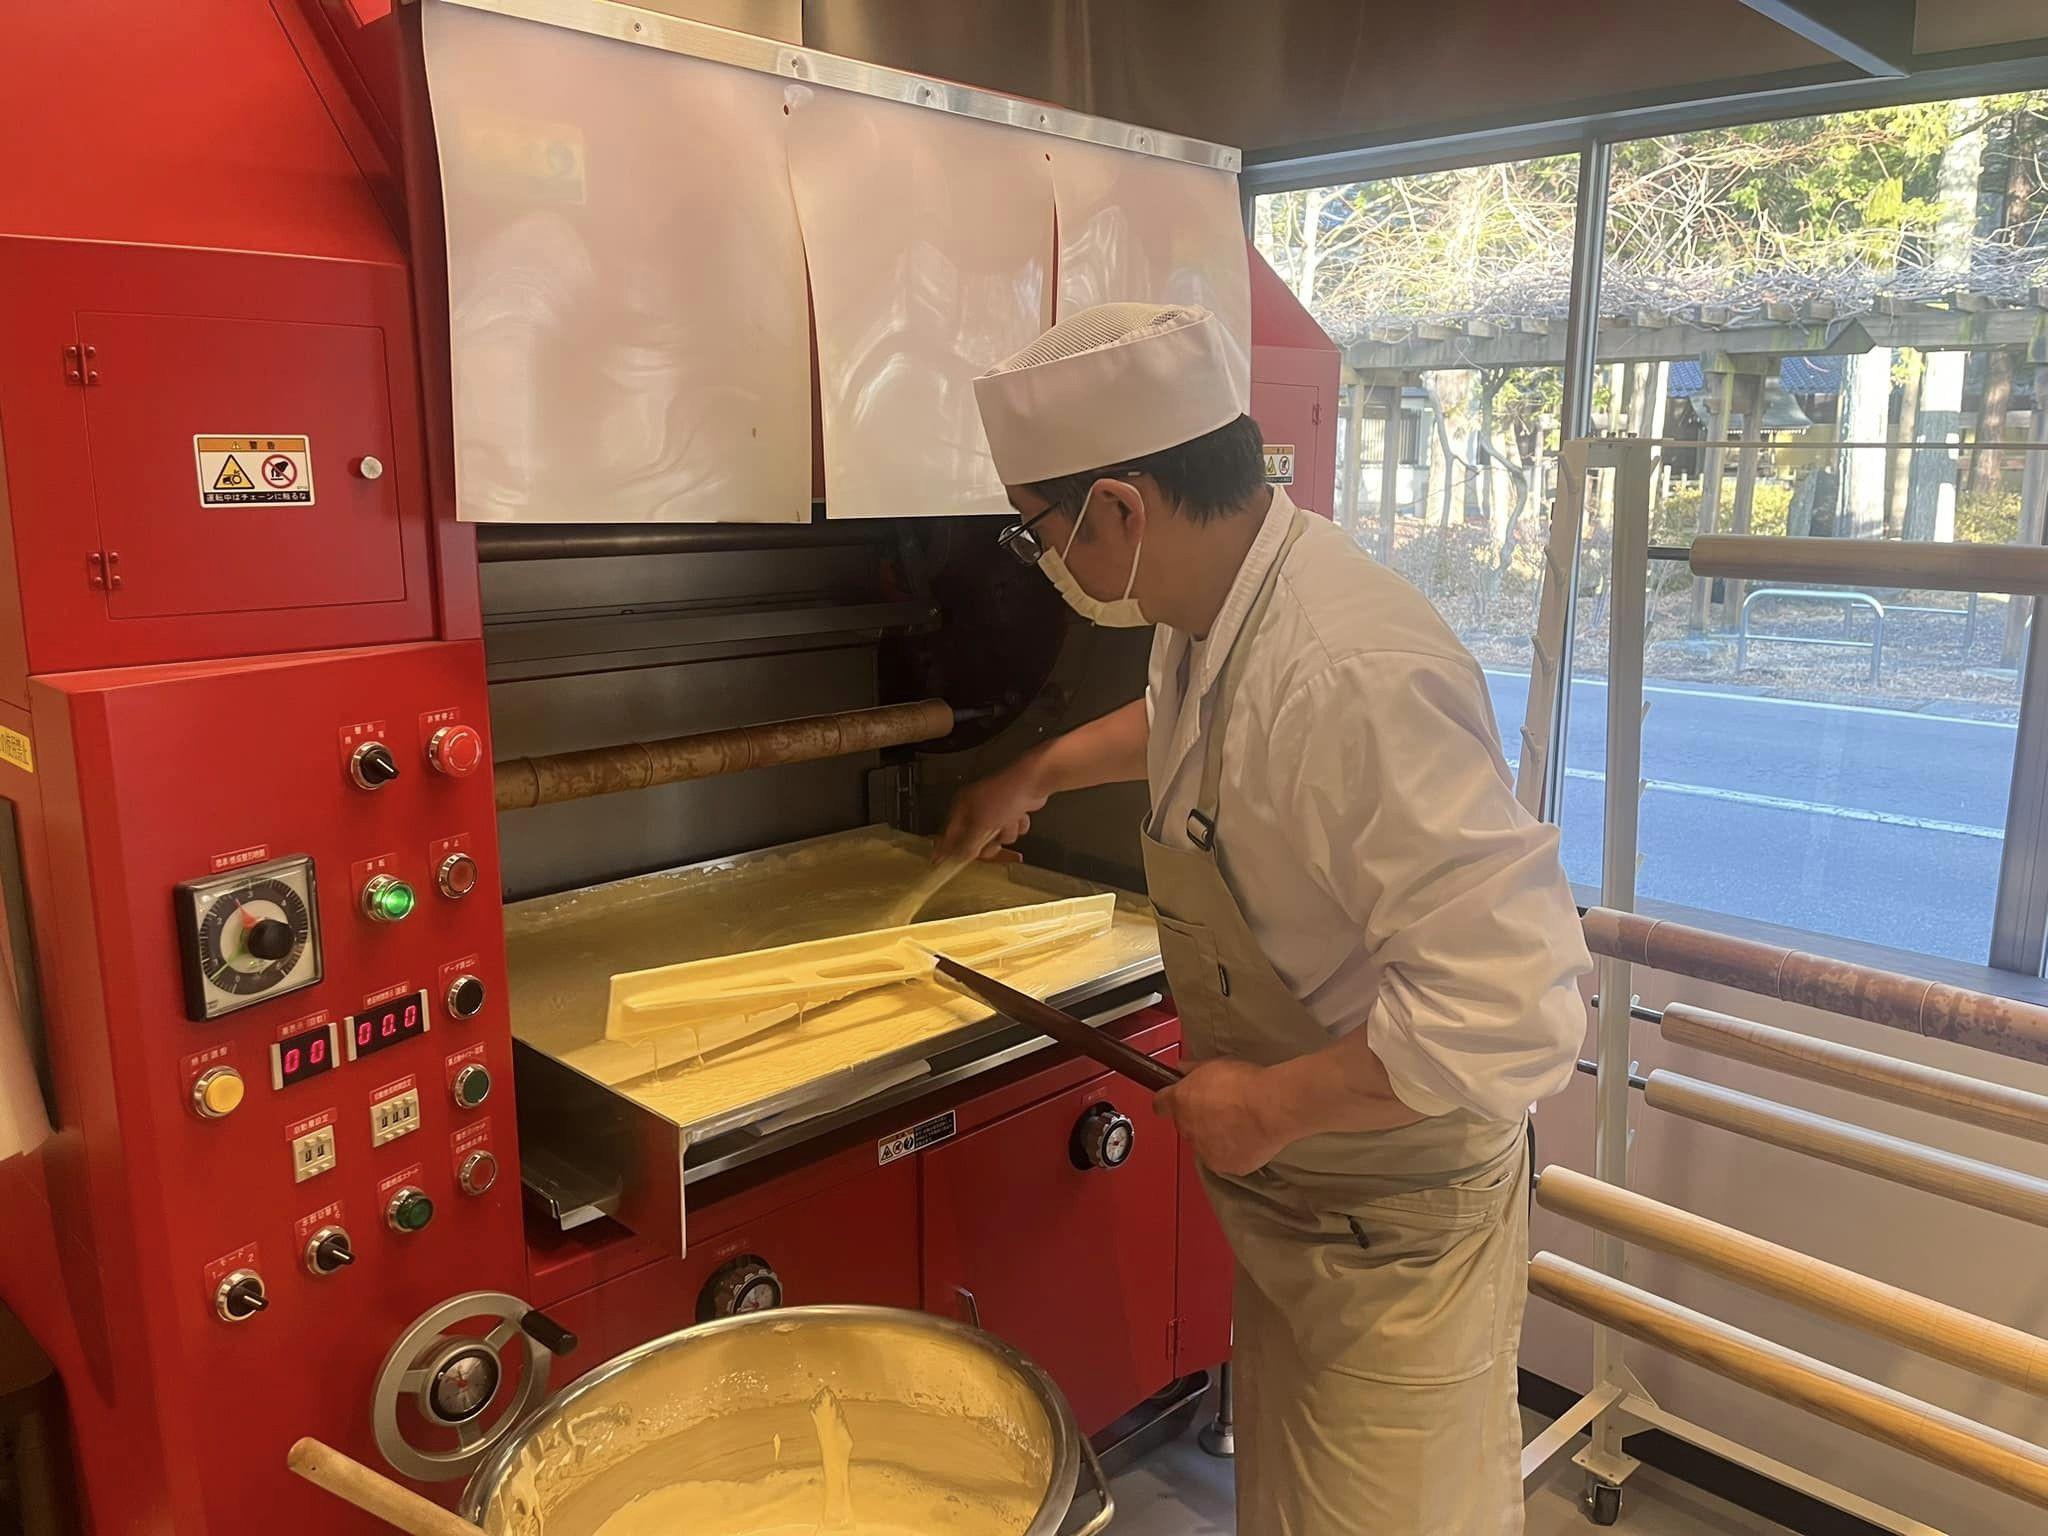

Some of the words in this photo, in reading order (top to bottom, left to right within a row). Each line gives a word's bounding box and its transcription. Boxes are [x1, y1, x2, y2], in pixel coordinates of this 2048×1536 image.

[206, 493, 307, 502] 運転中はチェーンに触るな
[220, 1250, 244, 1266] モード
[248, 1253, 254, 1263] 2
